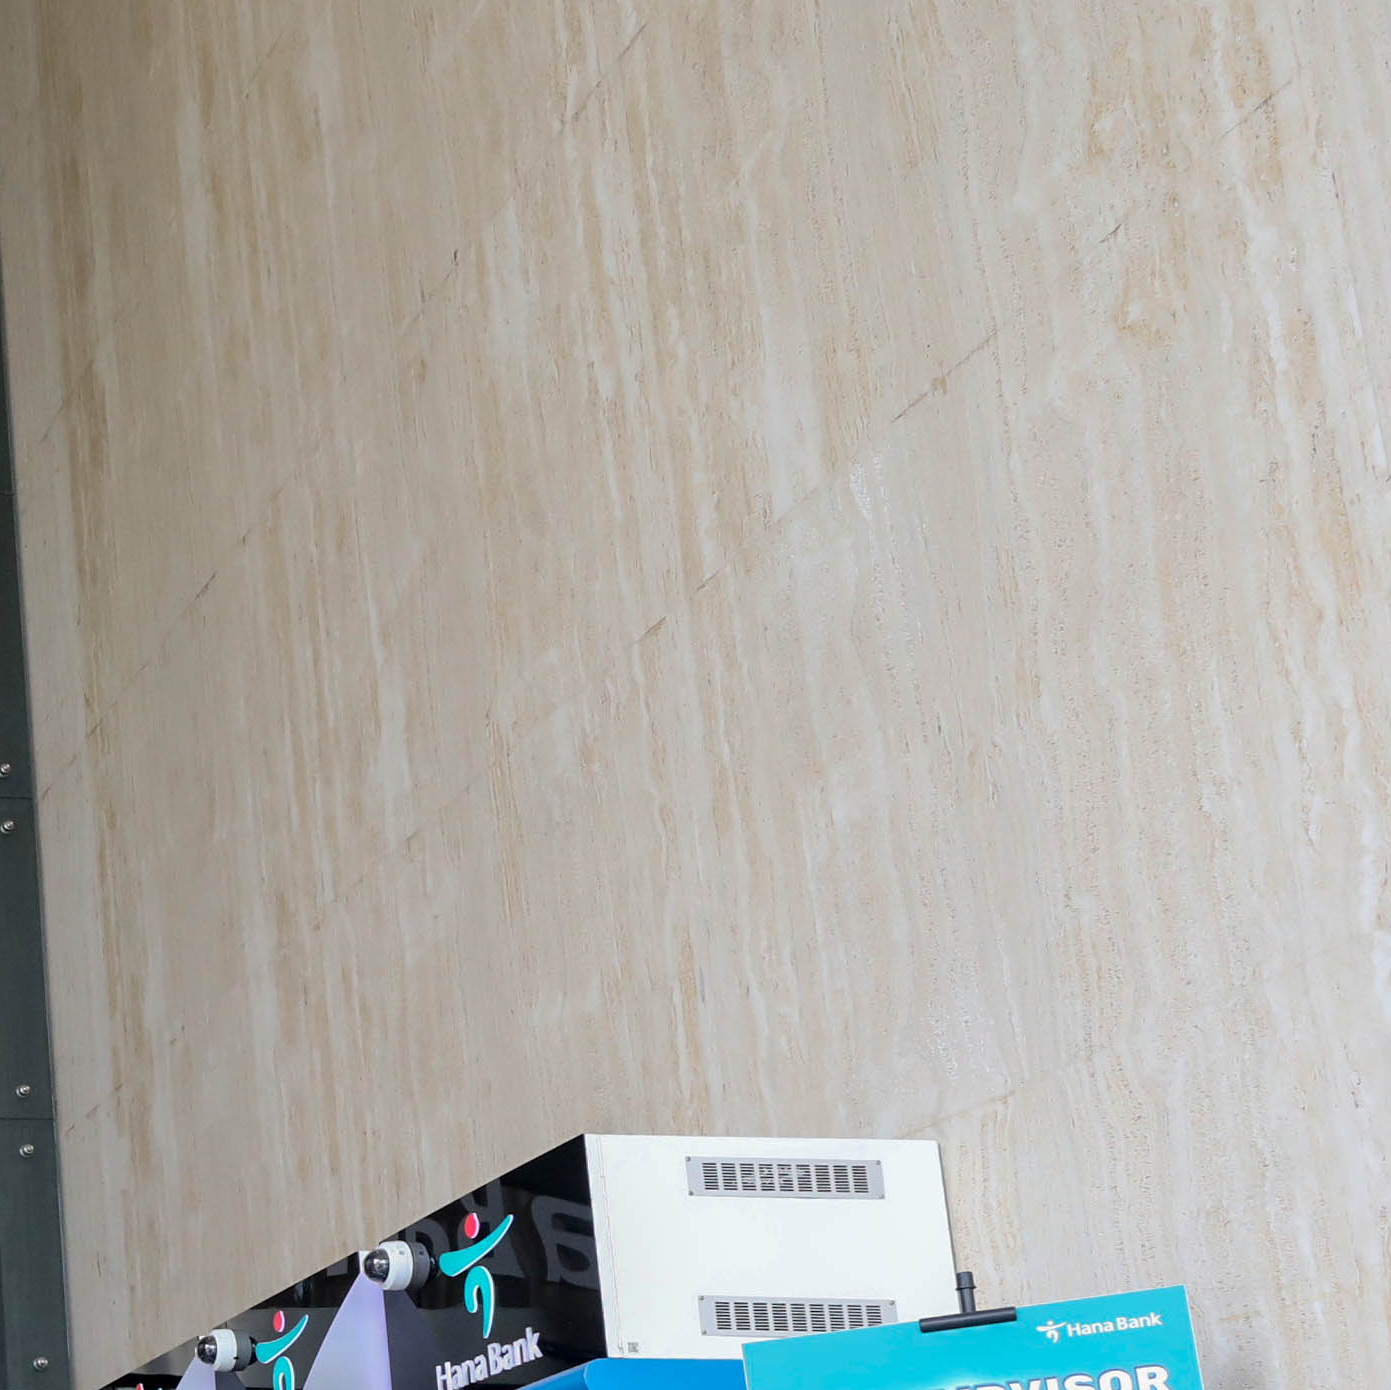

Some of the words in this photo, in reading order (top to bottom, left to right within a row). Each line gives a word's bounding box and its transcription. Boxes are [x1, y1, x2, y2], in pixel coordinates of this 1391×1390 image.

[1067, 1319, 1114, 1337] Hana
[1116, 1313, 1162, 1331] Bank
[487, 1326, 543, 1376] Bank
